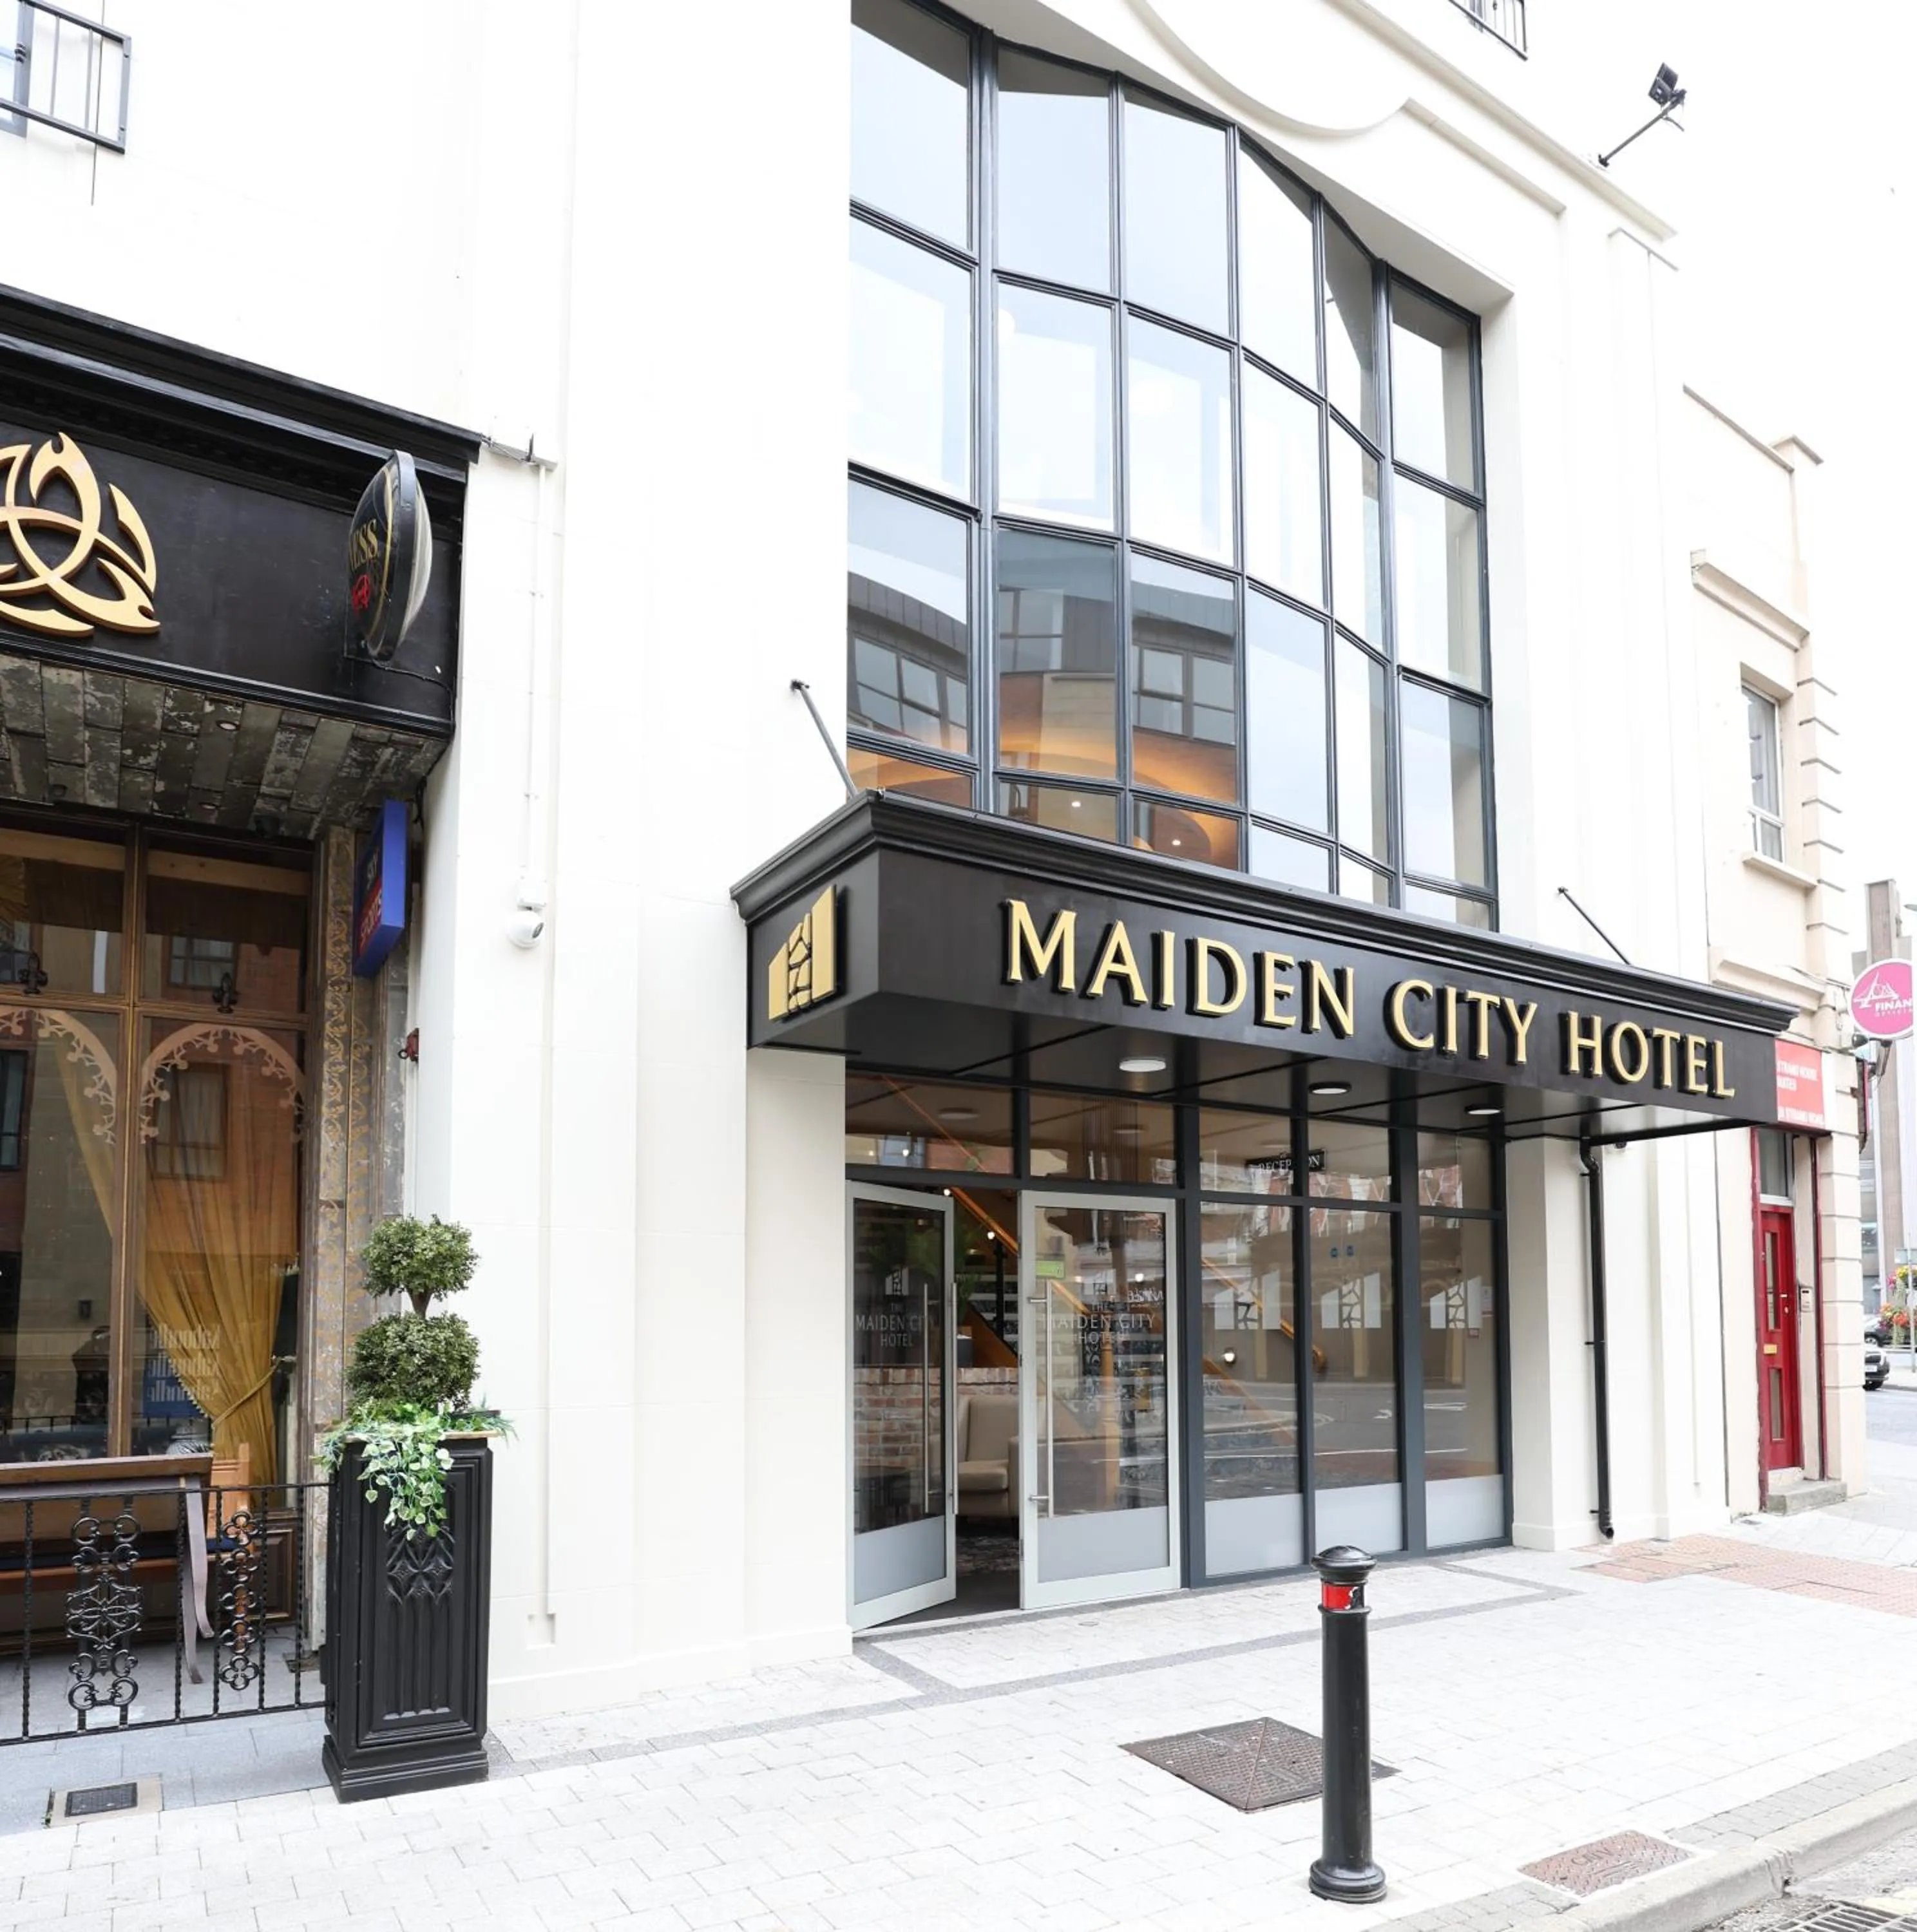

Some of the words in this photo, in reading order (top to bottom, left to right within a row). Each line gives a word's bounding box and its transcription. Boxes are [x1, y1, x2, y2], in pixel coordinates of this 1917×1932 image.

[1007, 899, 1355, 1036] MAIDEN
[1391, 979, 1538, 1064] CITY
[1567, 1010, 1735, 1098] HOTEL
[1258, 1154, 1320, 1172] RECEPN
[855, 1314, 904, 1331] MAIDEN
[881, 1333, 913, 1347] HOTEL
